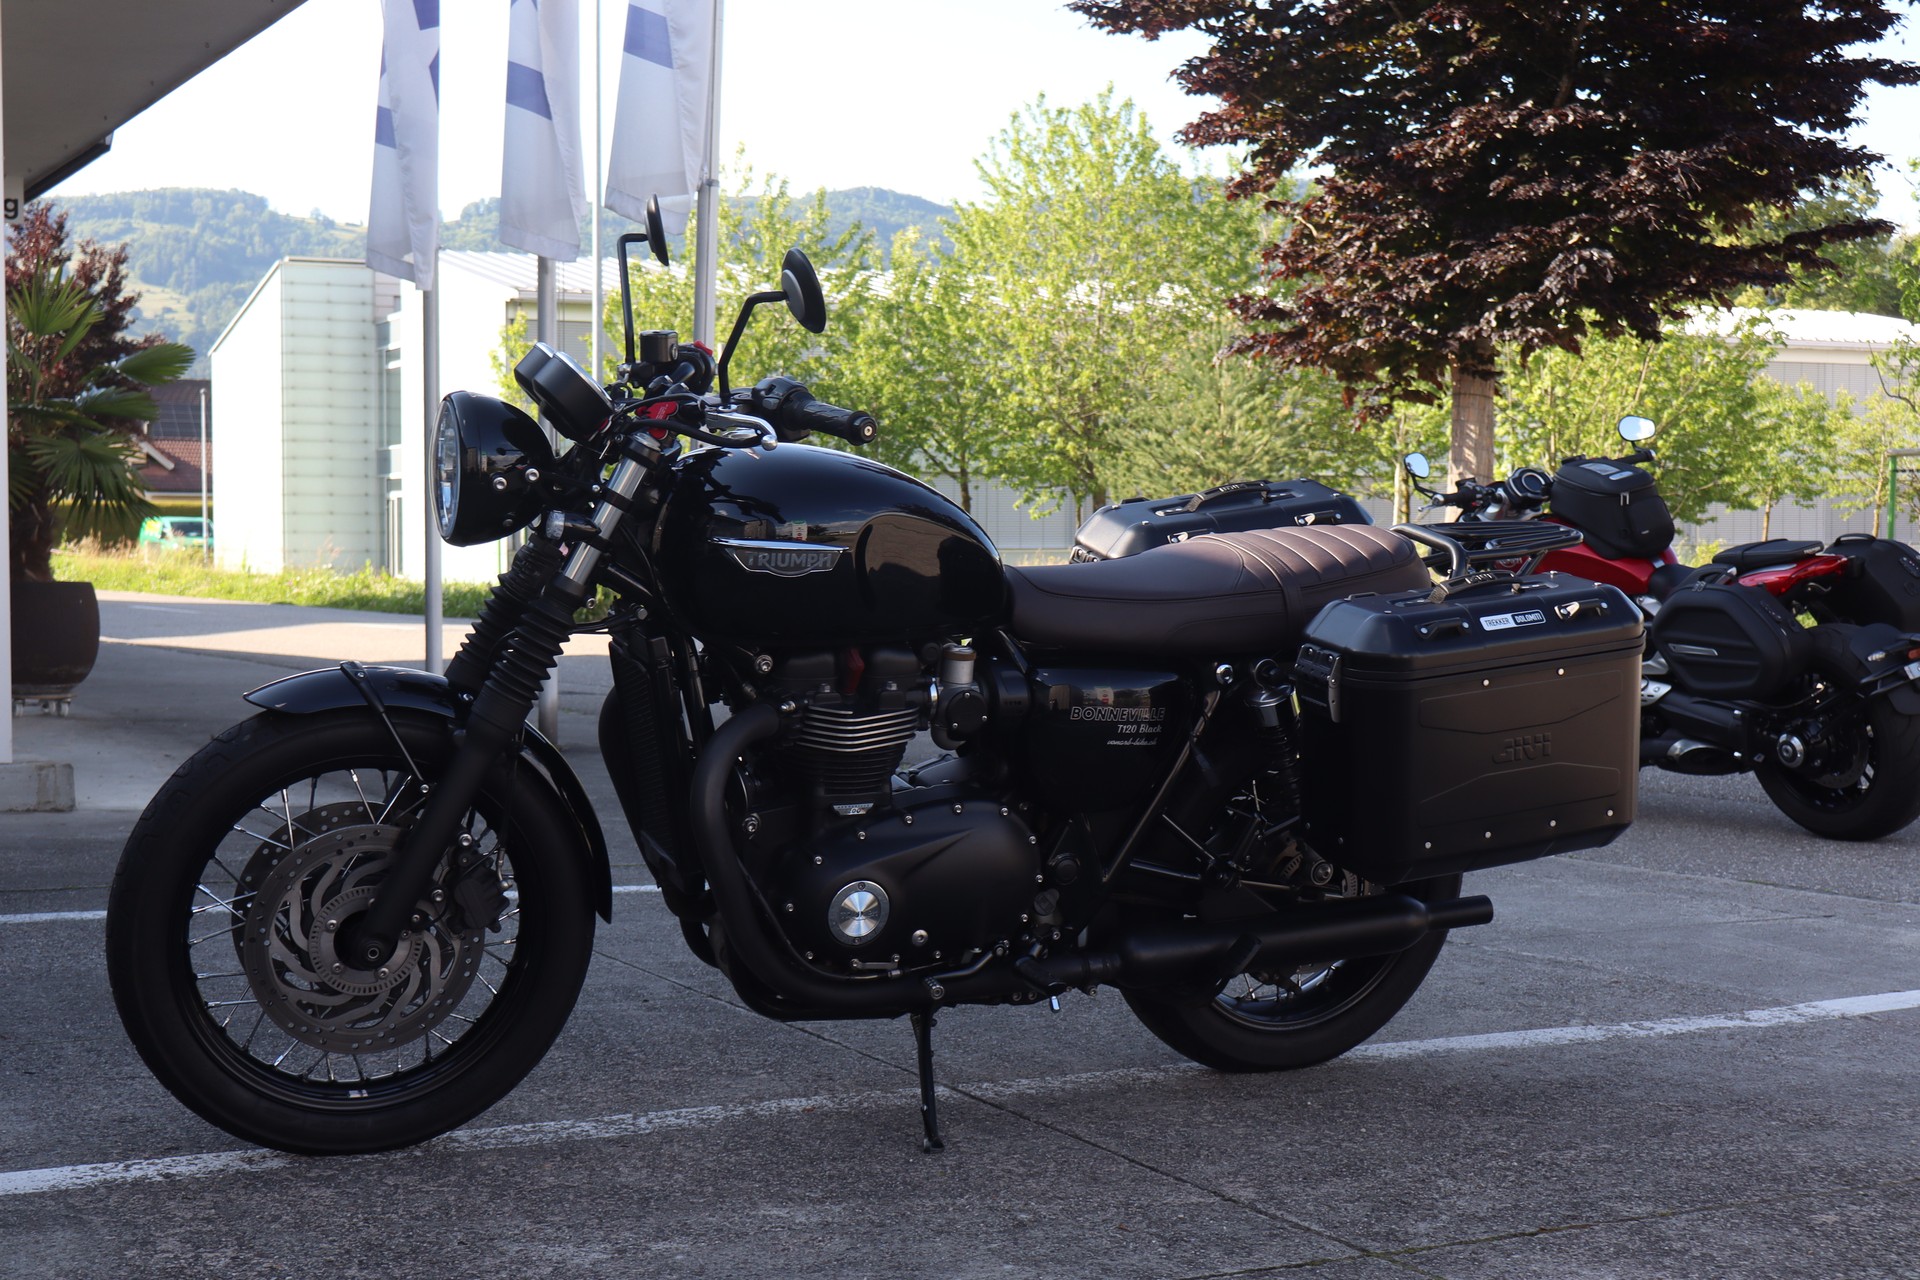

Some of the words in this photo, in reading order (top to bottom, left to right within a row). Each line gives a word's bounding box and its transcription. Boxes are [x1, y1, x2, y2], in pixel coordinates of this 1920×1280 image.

[746, 552, 832, 567] TRIUMPH
[1485, 618, 1510, 627] TREKKER
[1514, 612, 1543, 623] DOLOMITI
[1070, 706, 1166, 721] BONNEVILLE
[1117, 724, 1137, 733] T120
[1139, 723, 1162, 733] Black
